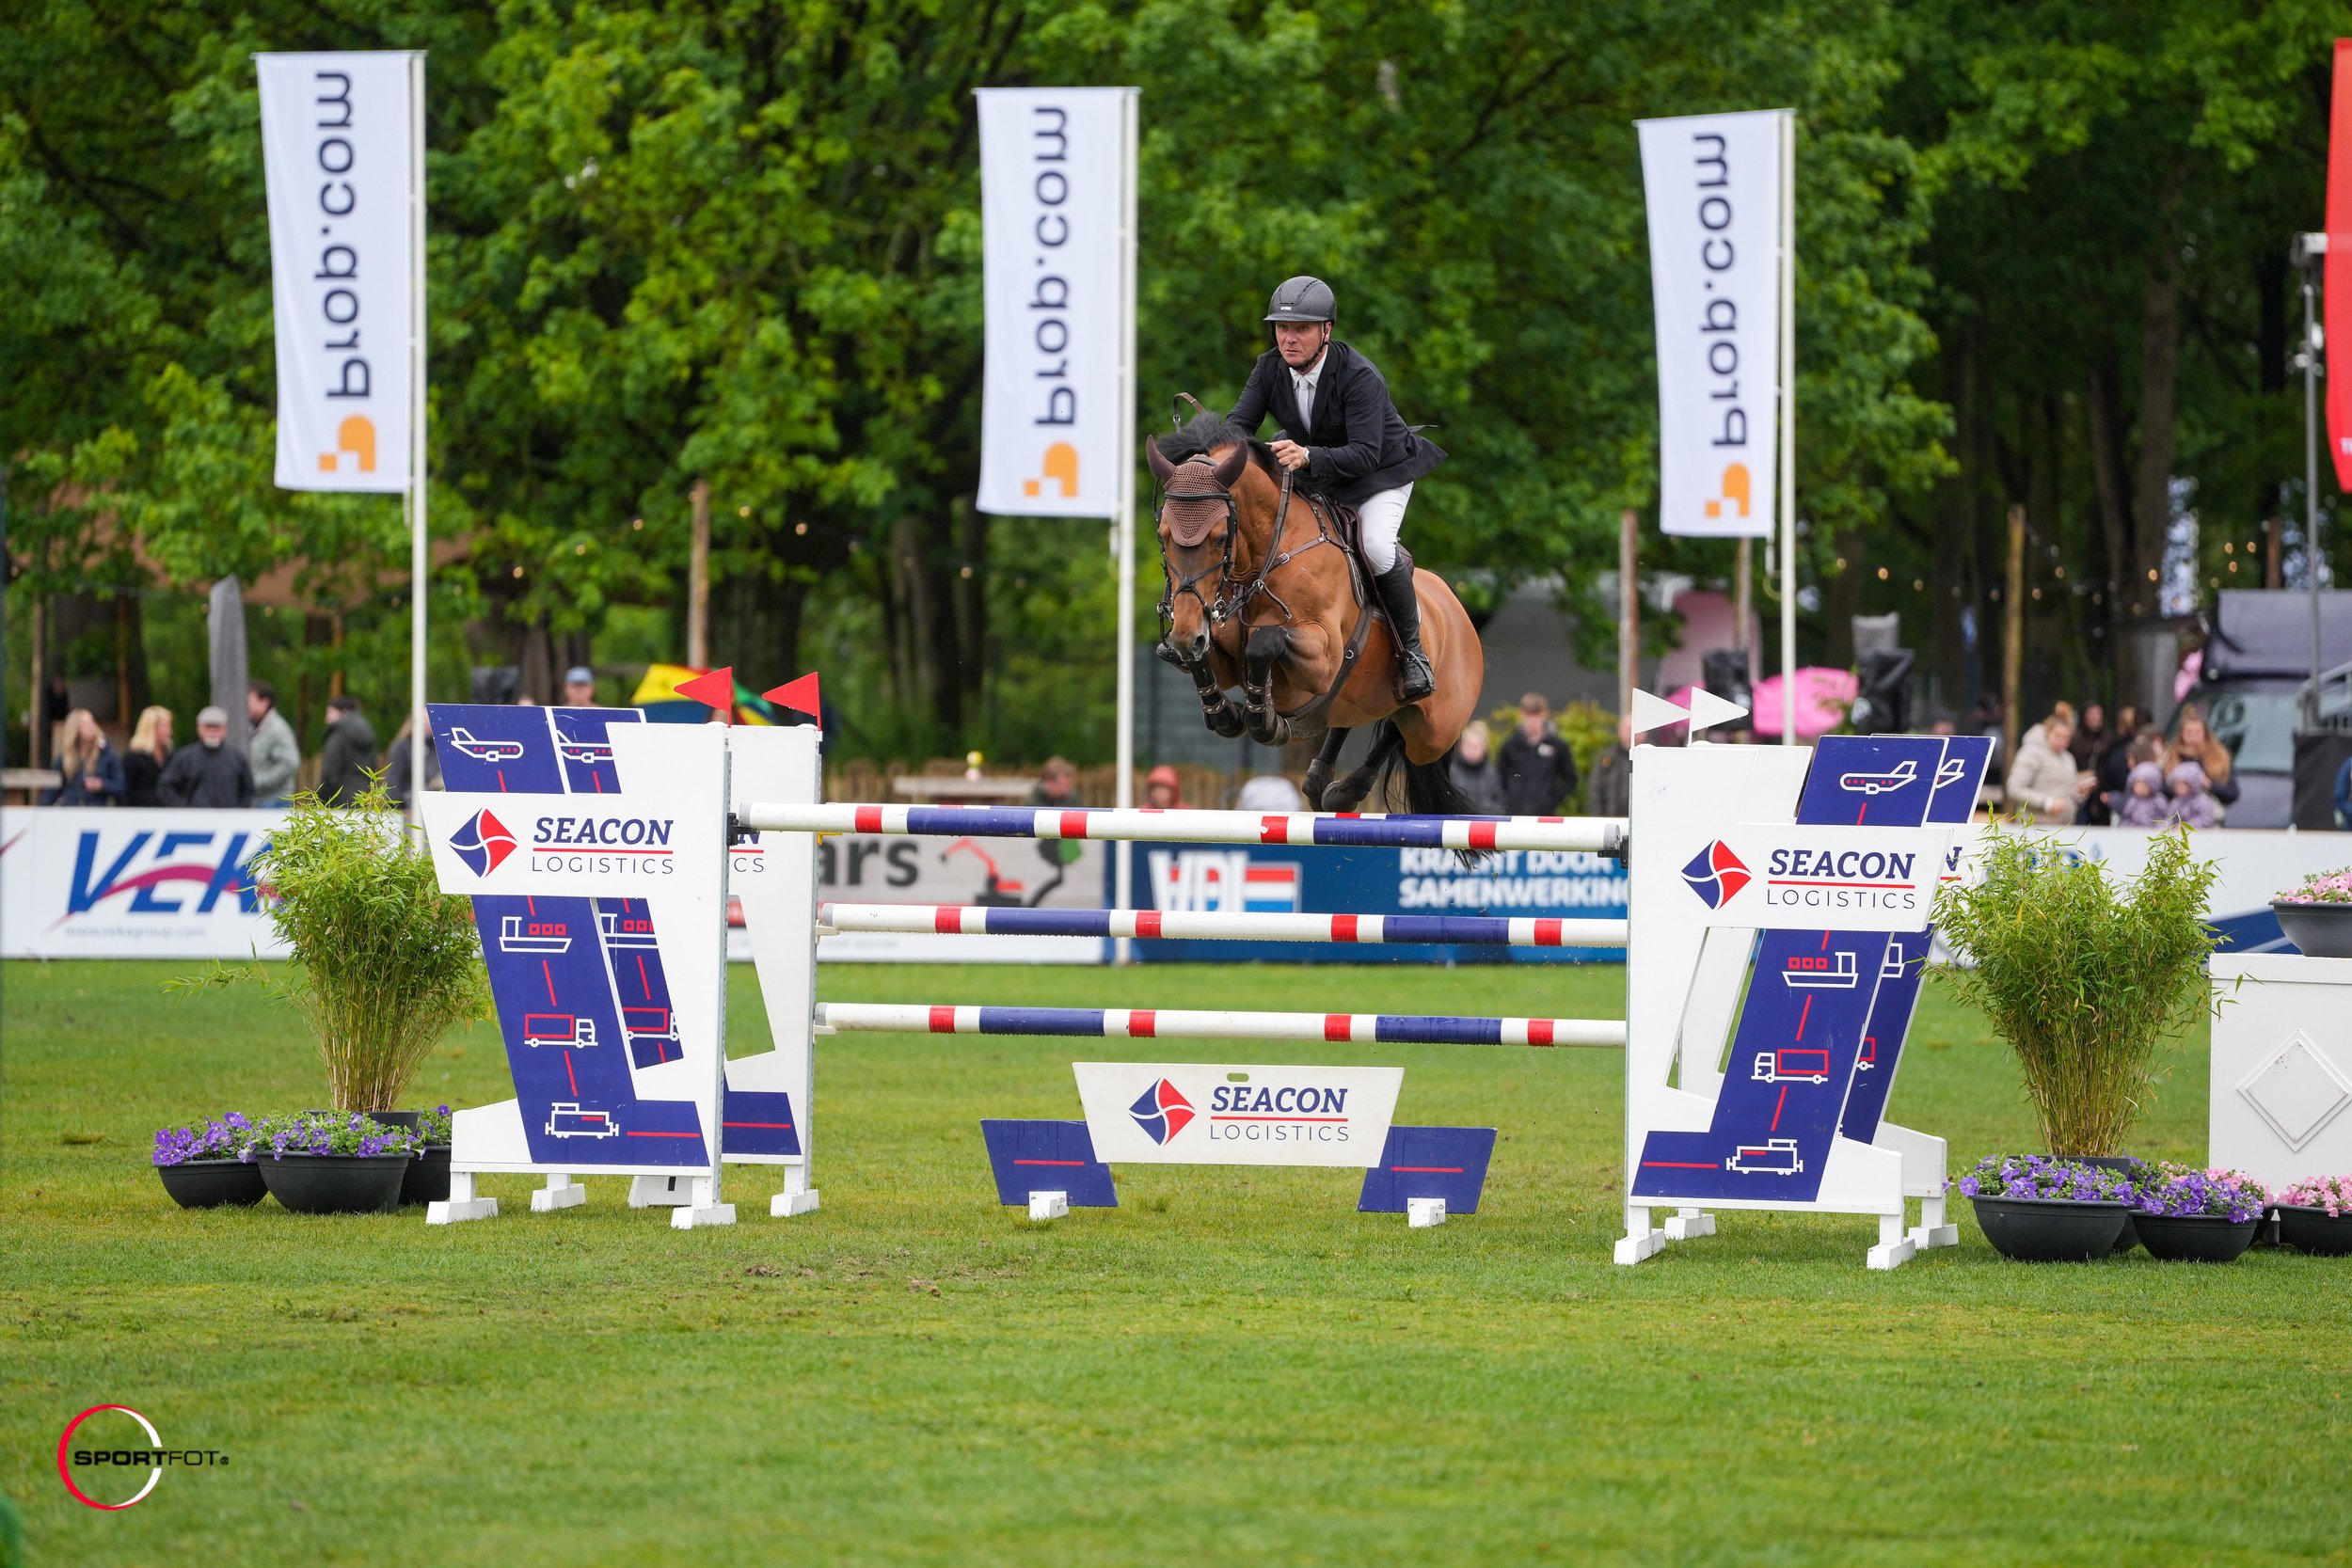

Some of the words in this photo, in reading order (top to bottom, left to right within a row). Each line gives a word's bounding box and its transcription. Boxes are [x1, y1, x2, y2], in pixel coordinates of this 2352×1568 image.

[533, 817, 674, 845] SEACON
[68, 831, 294, 913] VEK
[532, 857, 674, 874] LOGISTICS
[1769, 849, 1915, 879] SEACON
[1398, 877, 1629, 908] SAMENWERKIN
[1767, 889, 1915, 909] LOGISTICS
[1211, 1086, 1348, 1113] SEACON
[1210, 1124, 1349, 1141] LOGISTICS
